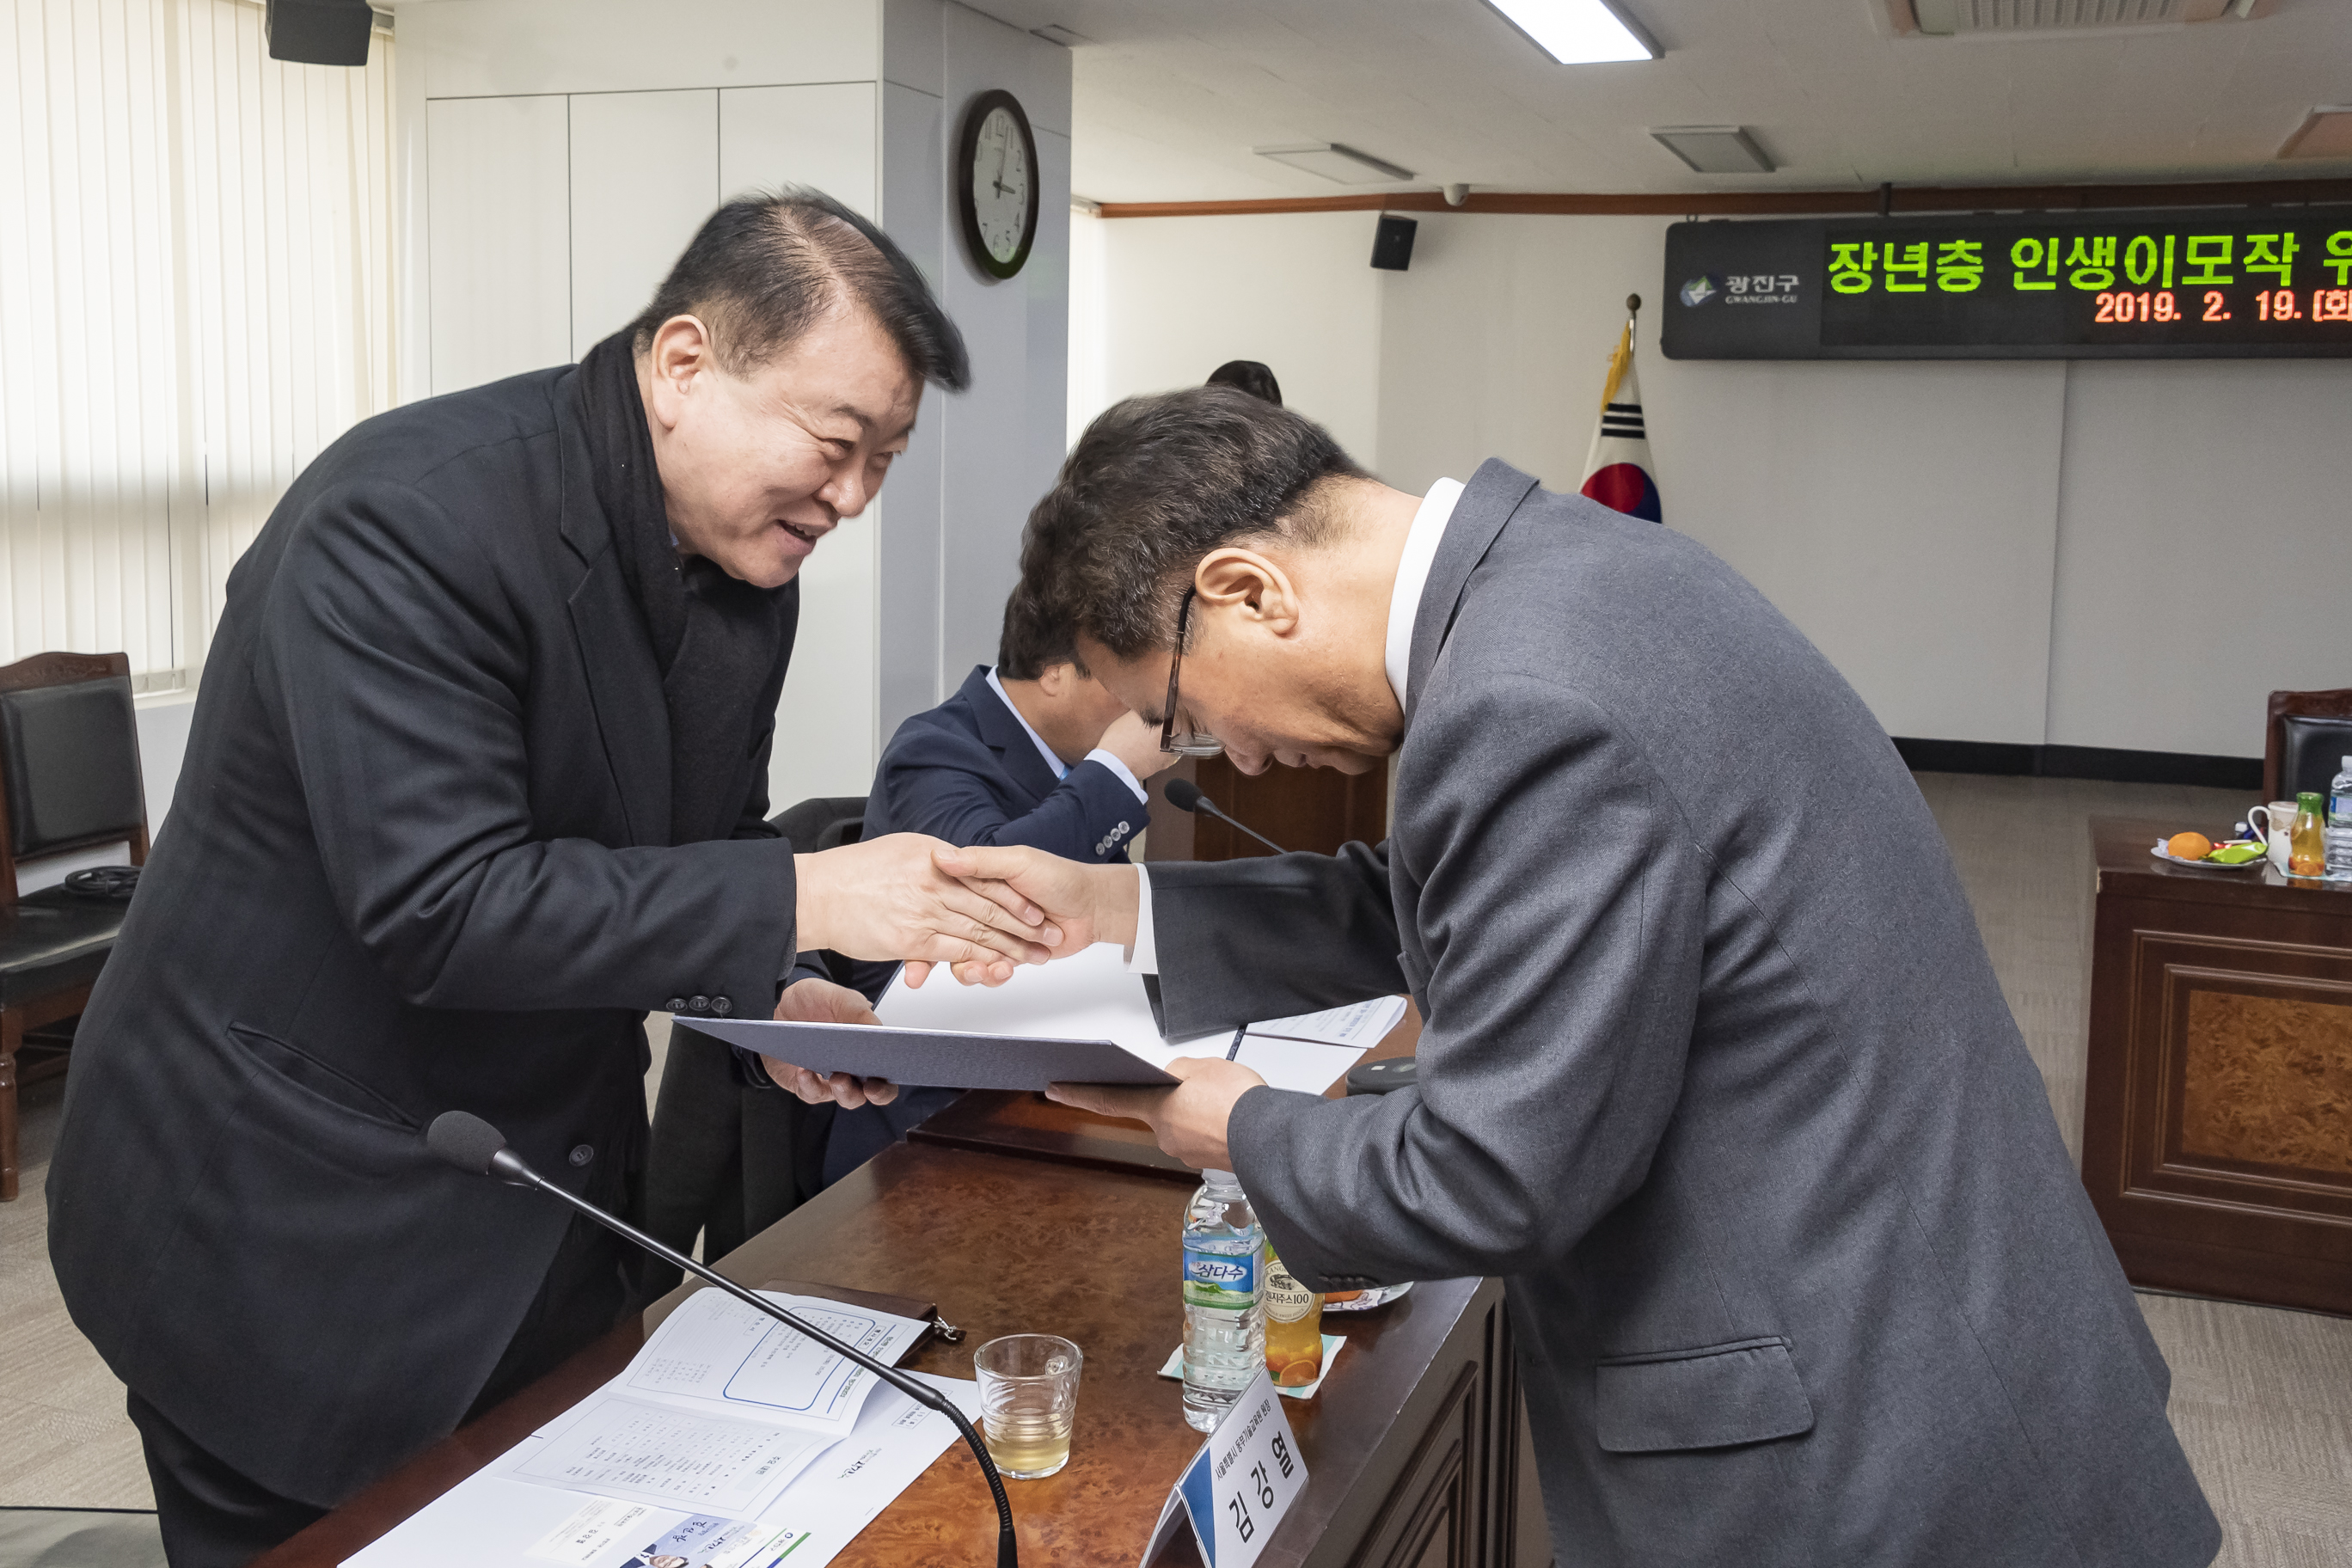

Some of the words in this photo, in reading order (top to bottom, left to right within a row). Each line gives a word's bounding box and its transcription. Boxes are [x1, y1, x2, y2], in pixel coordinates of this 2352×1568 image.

[1828, 239, 1984, 294] 장년층
[2010, 232, 2300, 291] 인생이모작
[1724, 274, 1800, 294] 광진구
[2094, 291, 2182, 322] 2019.
[2202, 290, 2232, 322] 2.
[1198, 1264, 1244, 1281] 삼다수
